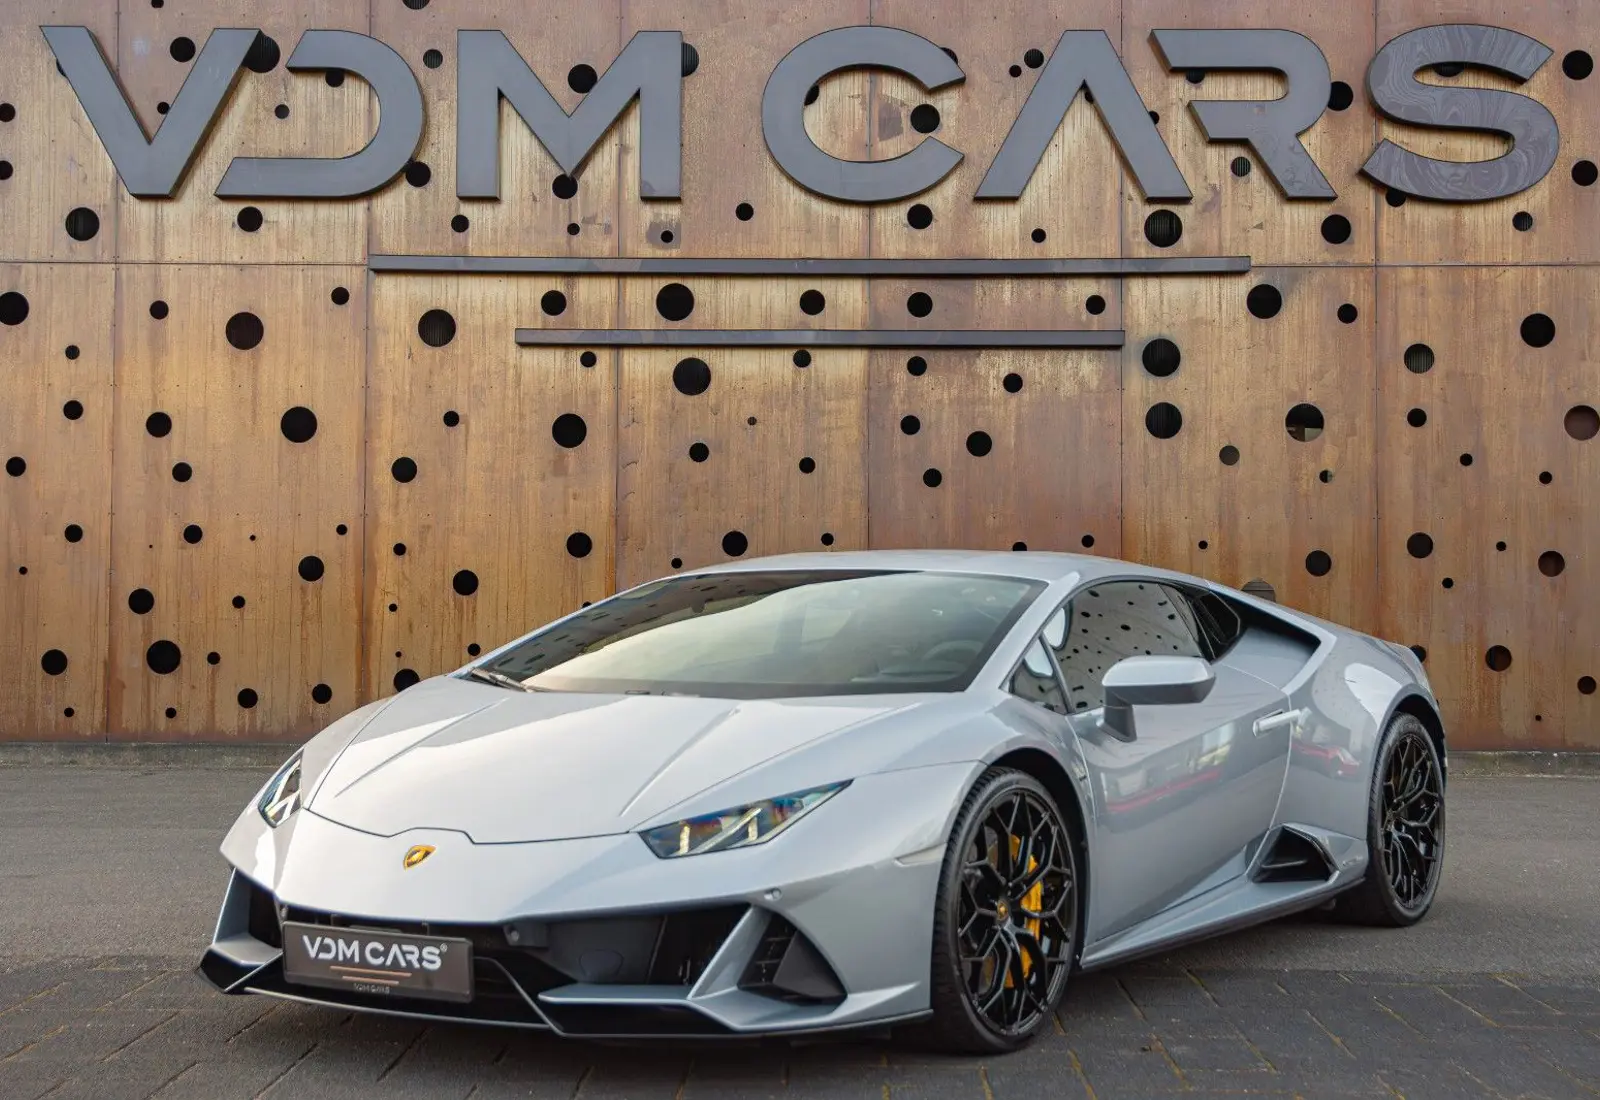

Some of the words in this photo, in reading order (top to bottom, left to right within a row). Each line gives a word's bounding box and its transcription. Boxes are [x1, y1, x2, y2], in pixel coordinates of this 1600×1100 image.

[39, 25, 682, 200] VDM
[761, 24, 1560, 203] CARS
[302, 935, 360, 963] VDM
